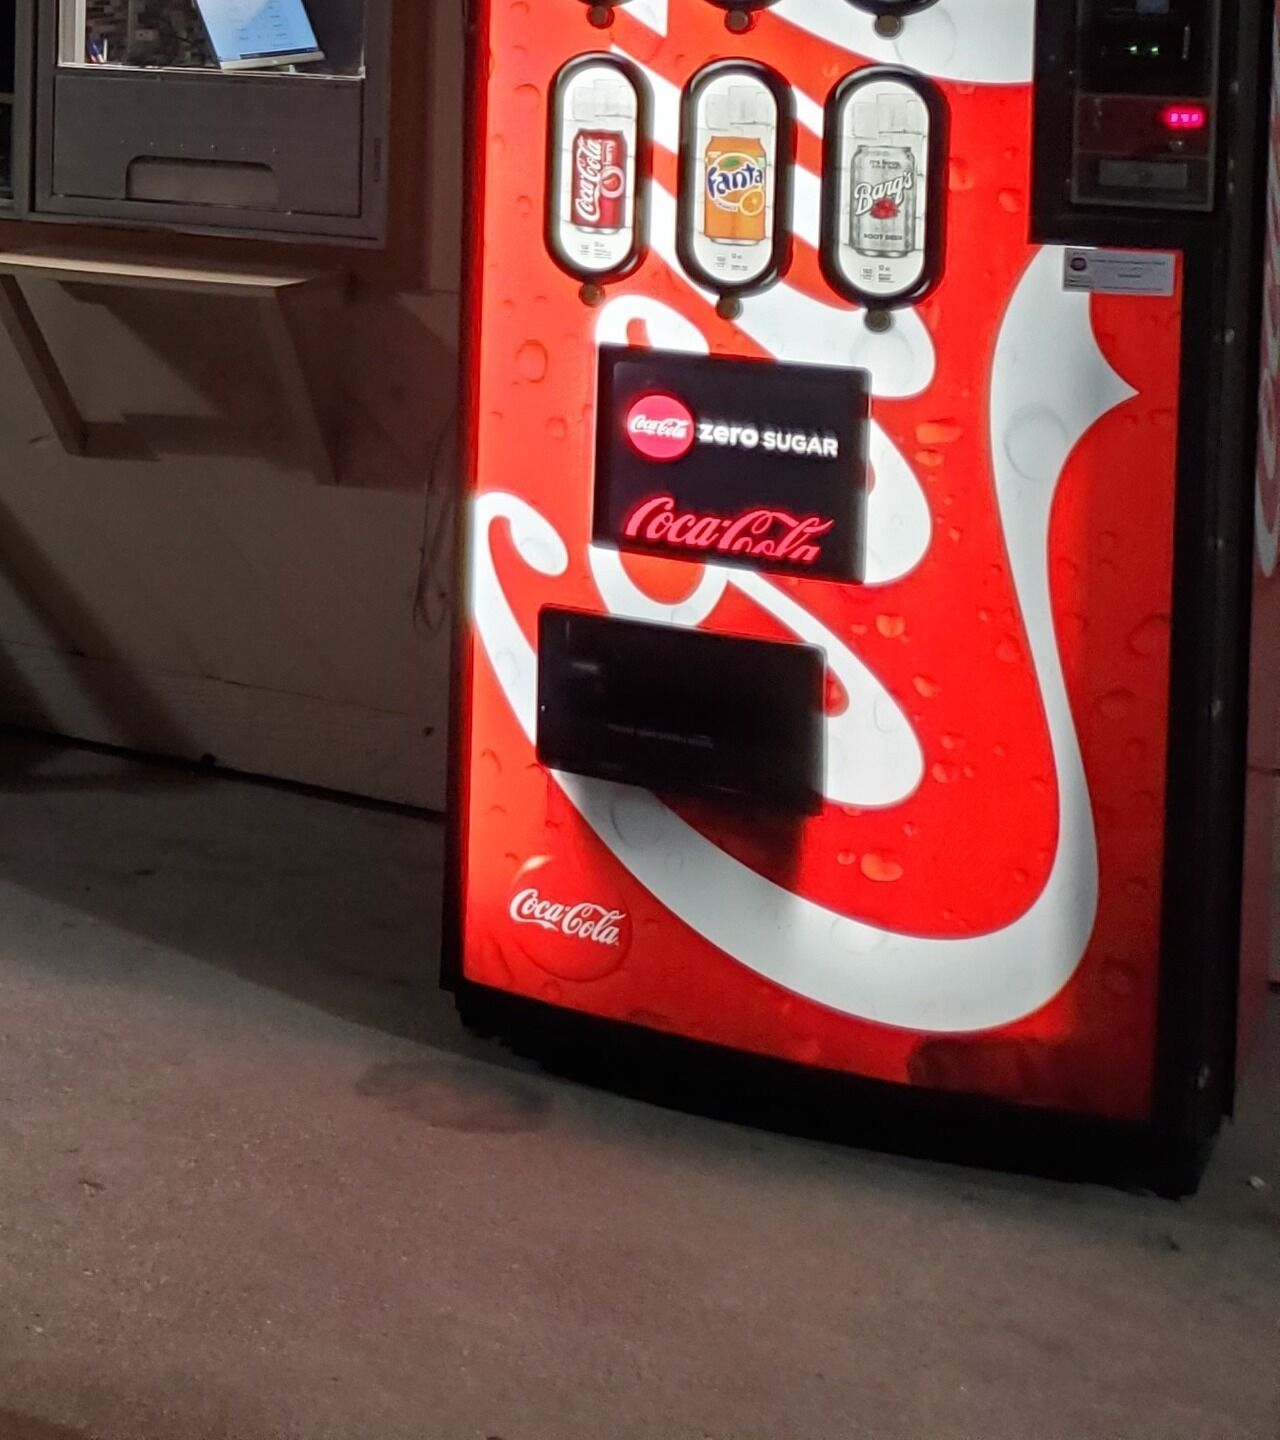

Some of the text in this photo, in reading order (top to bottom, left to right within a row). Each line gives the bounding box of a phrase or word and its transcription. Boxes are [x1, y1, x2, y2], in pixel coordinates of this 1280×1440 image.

[574, 136, 602, 222] Coca-Cola
[707, 162, 763, 200] Fanta
[854, 170, 913, 215] Barg's
[629, 414, 689, 439] Coca-Cola
[699, 422, 838, 458] zero SUGAR
[625, 496, 834, 560] Coca-Cola
[510, 888, 626, 946] Coca-Cola
